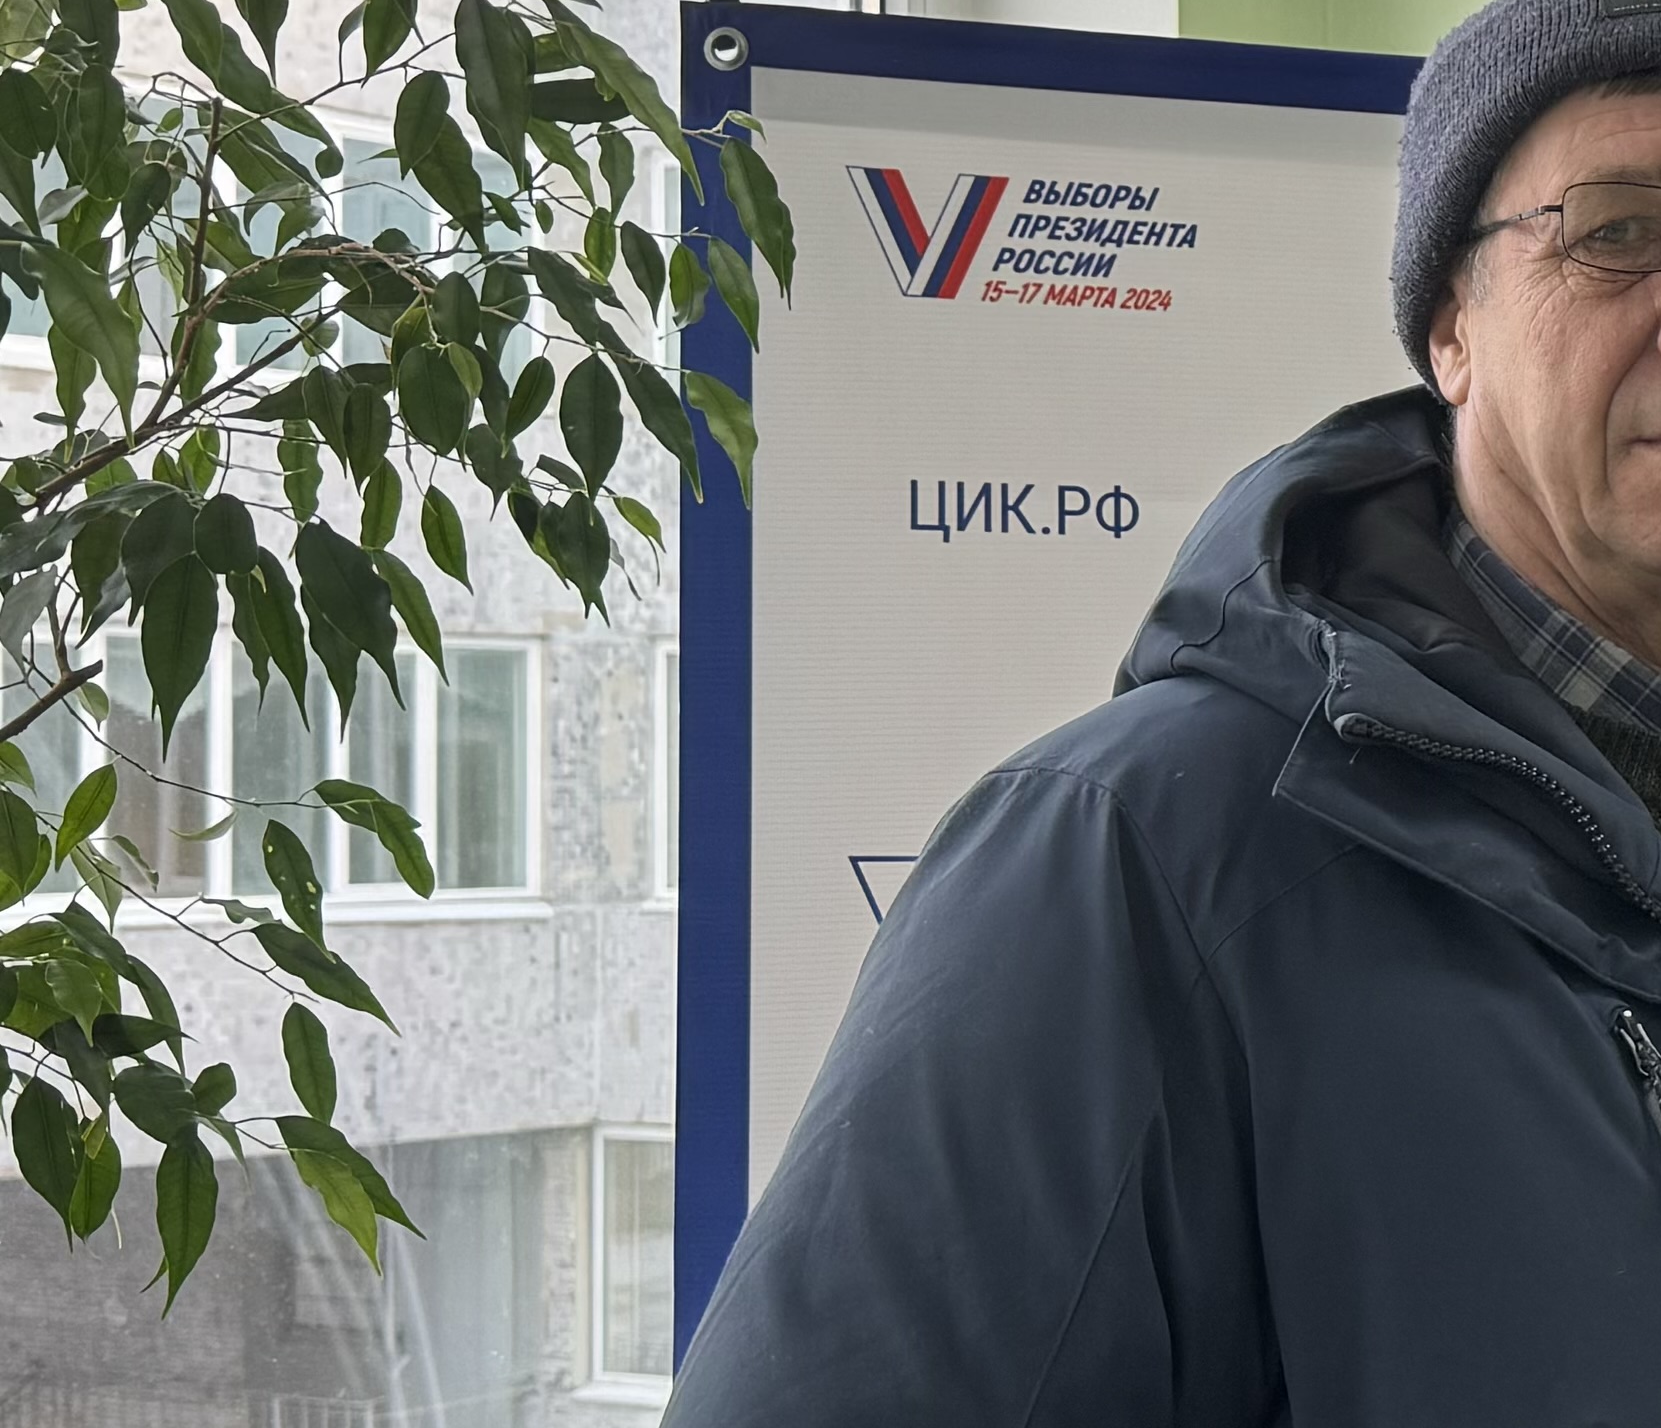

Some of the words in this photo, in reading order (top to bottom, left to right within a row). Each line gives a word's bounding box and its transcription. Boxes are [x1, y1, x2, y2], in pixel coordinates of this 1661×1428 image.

[1022, 179, 1160, 212] ВЫБОРЫ
[1007, 213, 1199, 249] ПРЕЗИДЕНТА
[991, 246, 1118, 279] РОССИИ
[1042, 283, 1118, 309] МАРТА
[1119, 287, 1173, 312] 2024
[909, 479, 1141, 544] ЦИК.РФ
